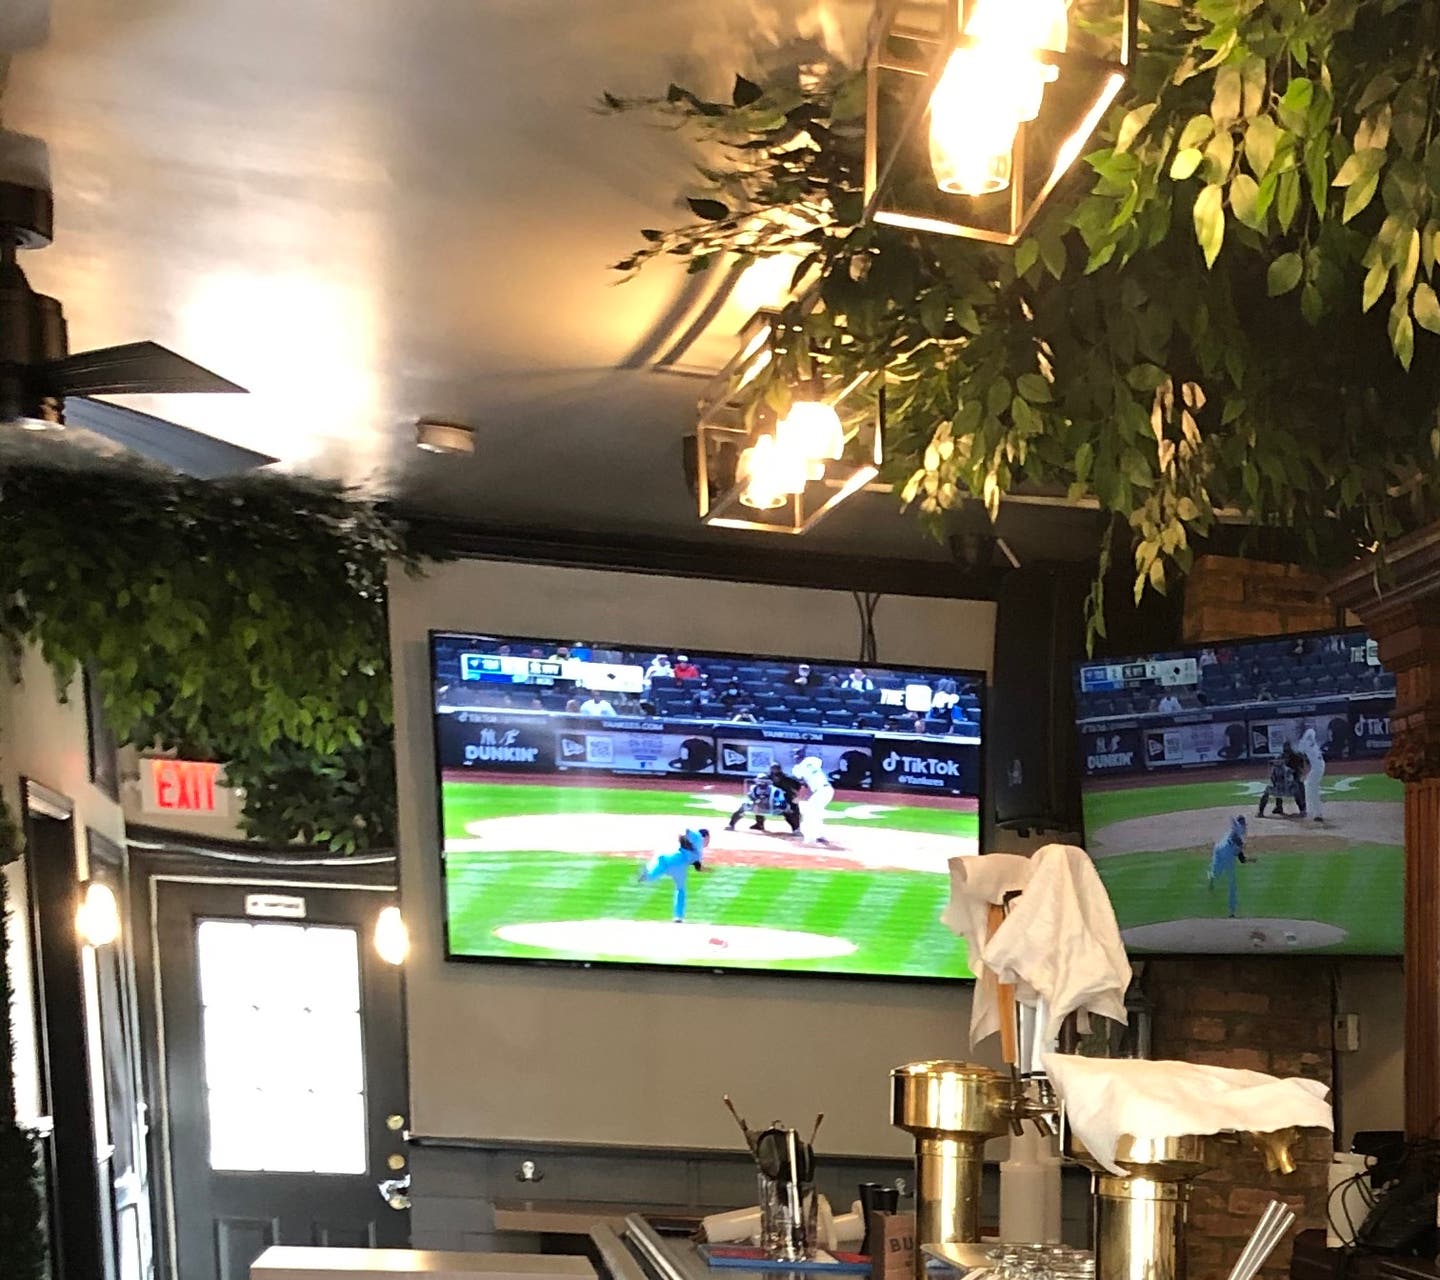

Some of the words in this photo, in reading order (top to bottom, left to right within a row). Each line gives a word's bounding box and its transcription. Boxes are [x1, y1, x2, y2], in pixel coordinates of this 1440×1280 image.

[880, 688, 906, 706] THE
[931, 691, 960, 709] APP
[465, 745, 538, 763] DUNKIN'
[902, 756, 961, 777] TikTok
[154, 760, 218, 810] EXIT
